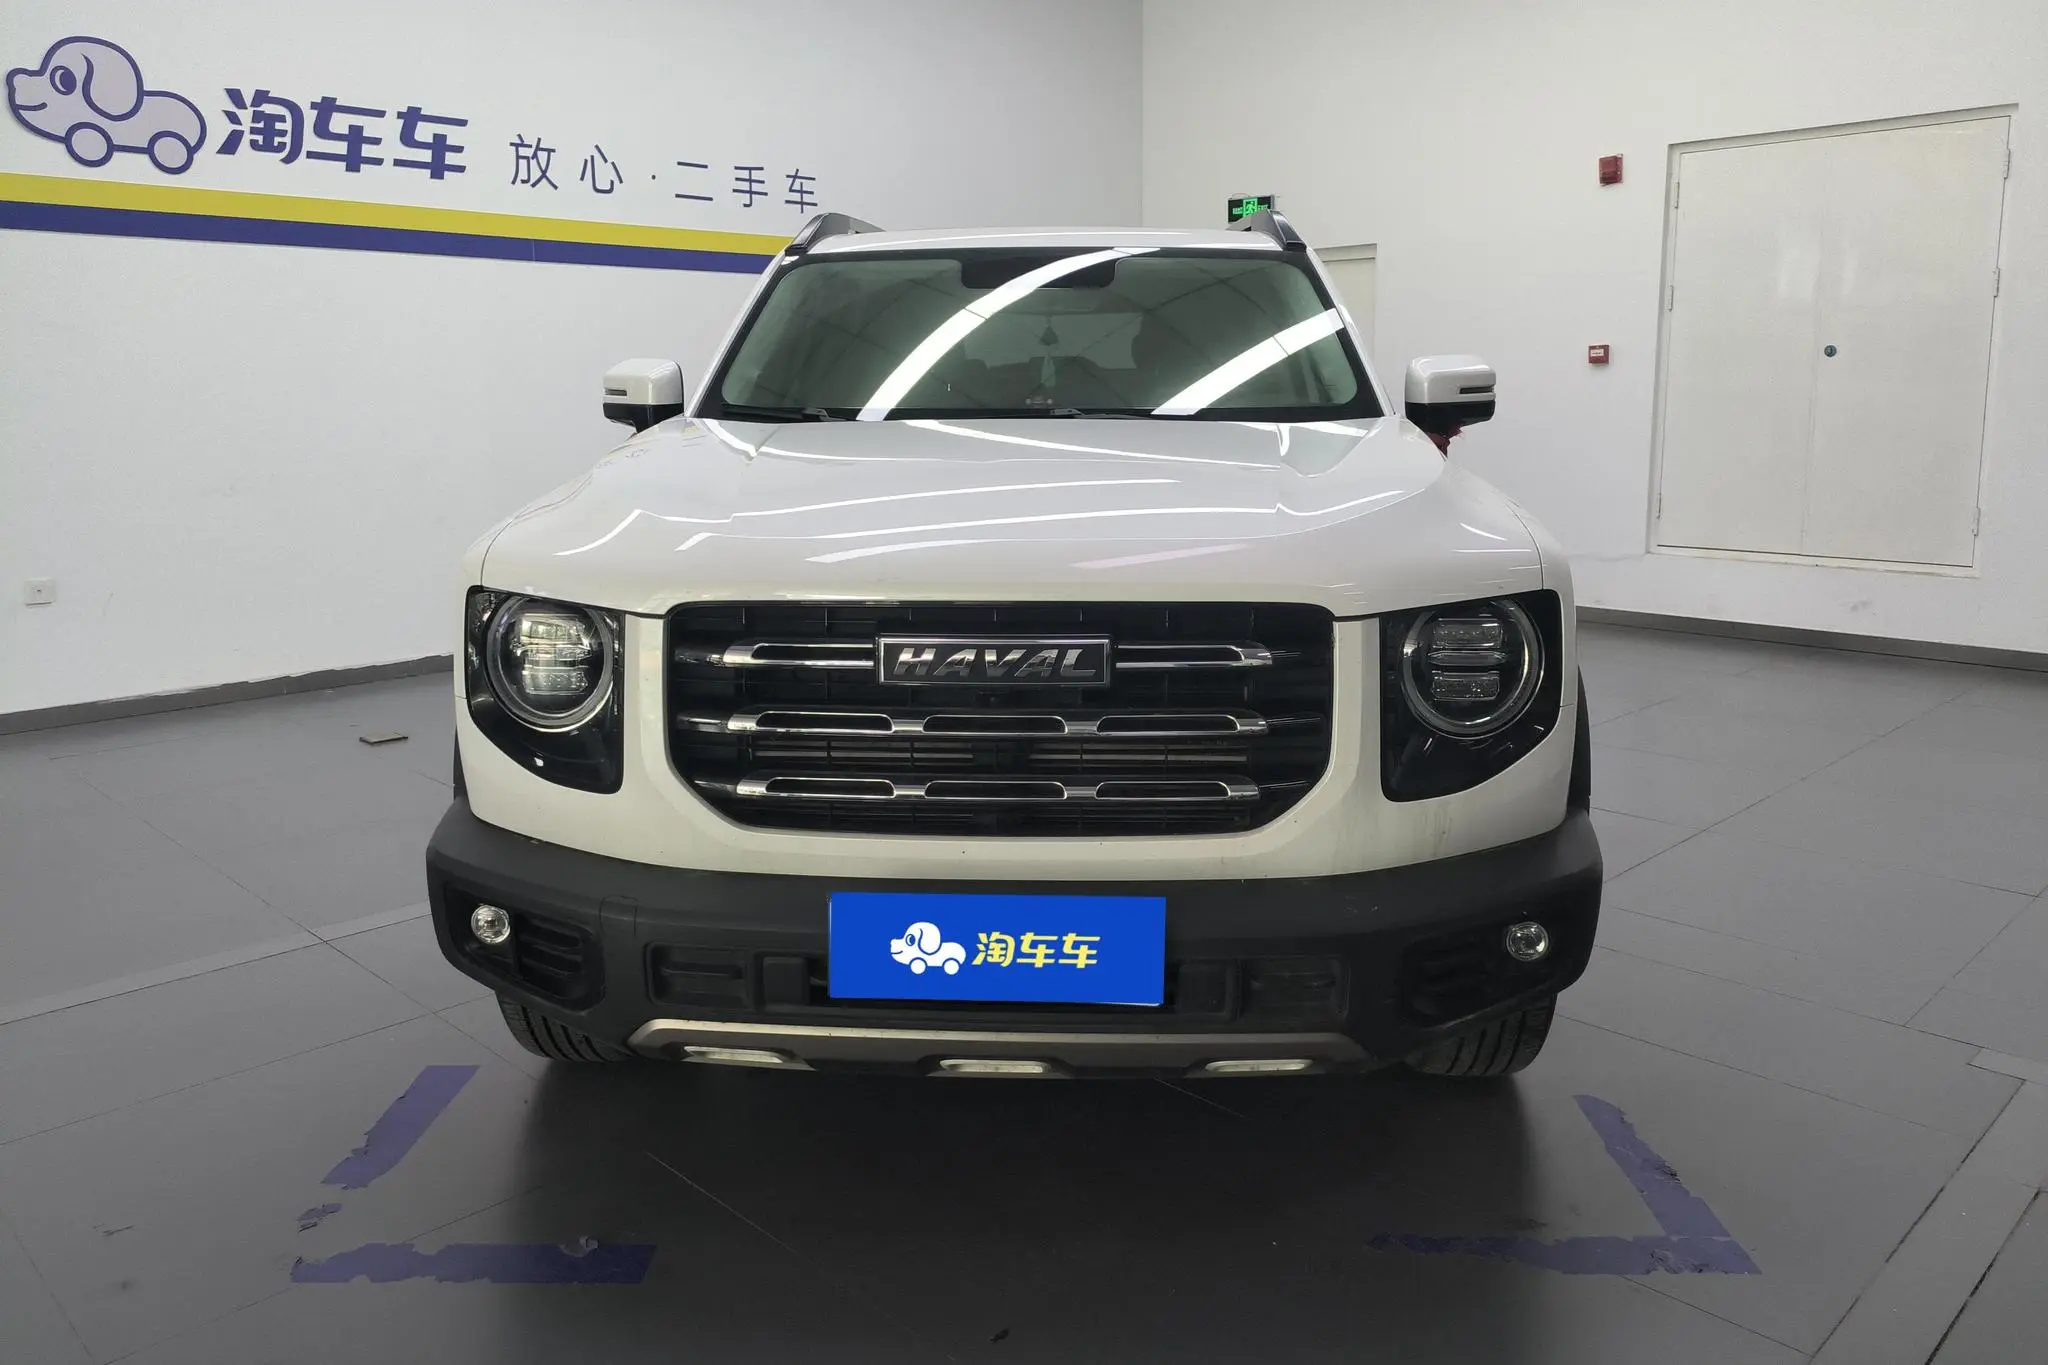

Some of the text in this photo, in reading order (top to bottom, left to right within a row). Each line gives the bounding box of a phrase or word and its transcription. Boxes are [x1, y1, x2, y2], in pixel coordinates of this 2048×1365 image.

[216, 88, 469, 179] 淘车车
[893, 647, 1097, 677] HAVAL
